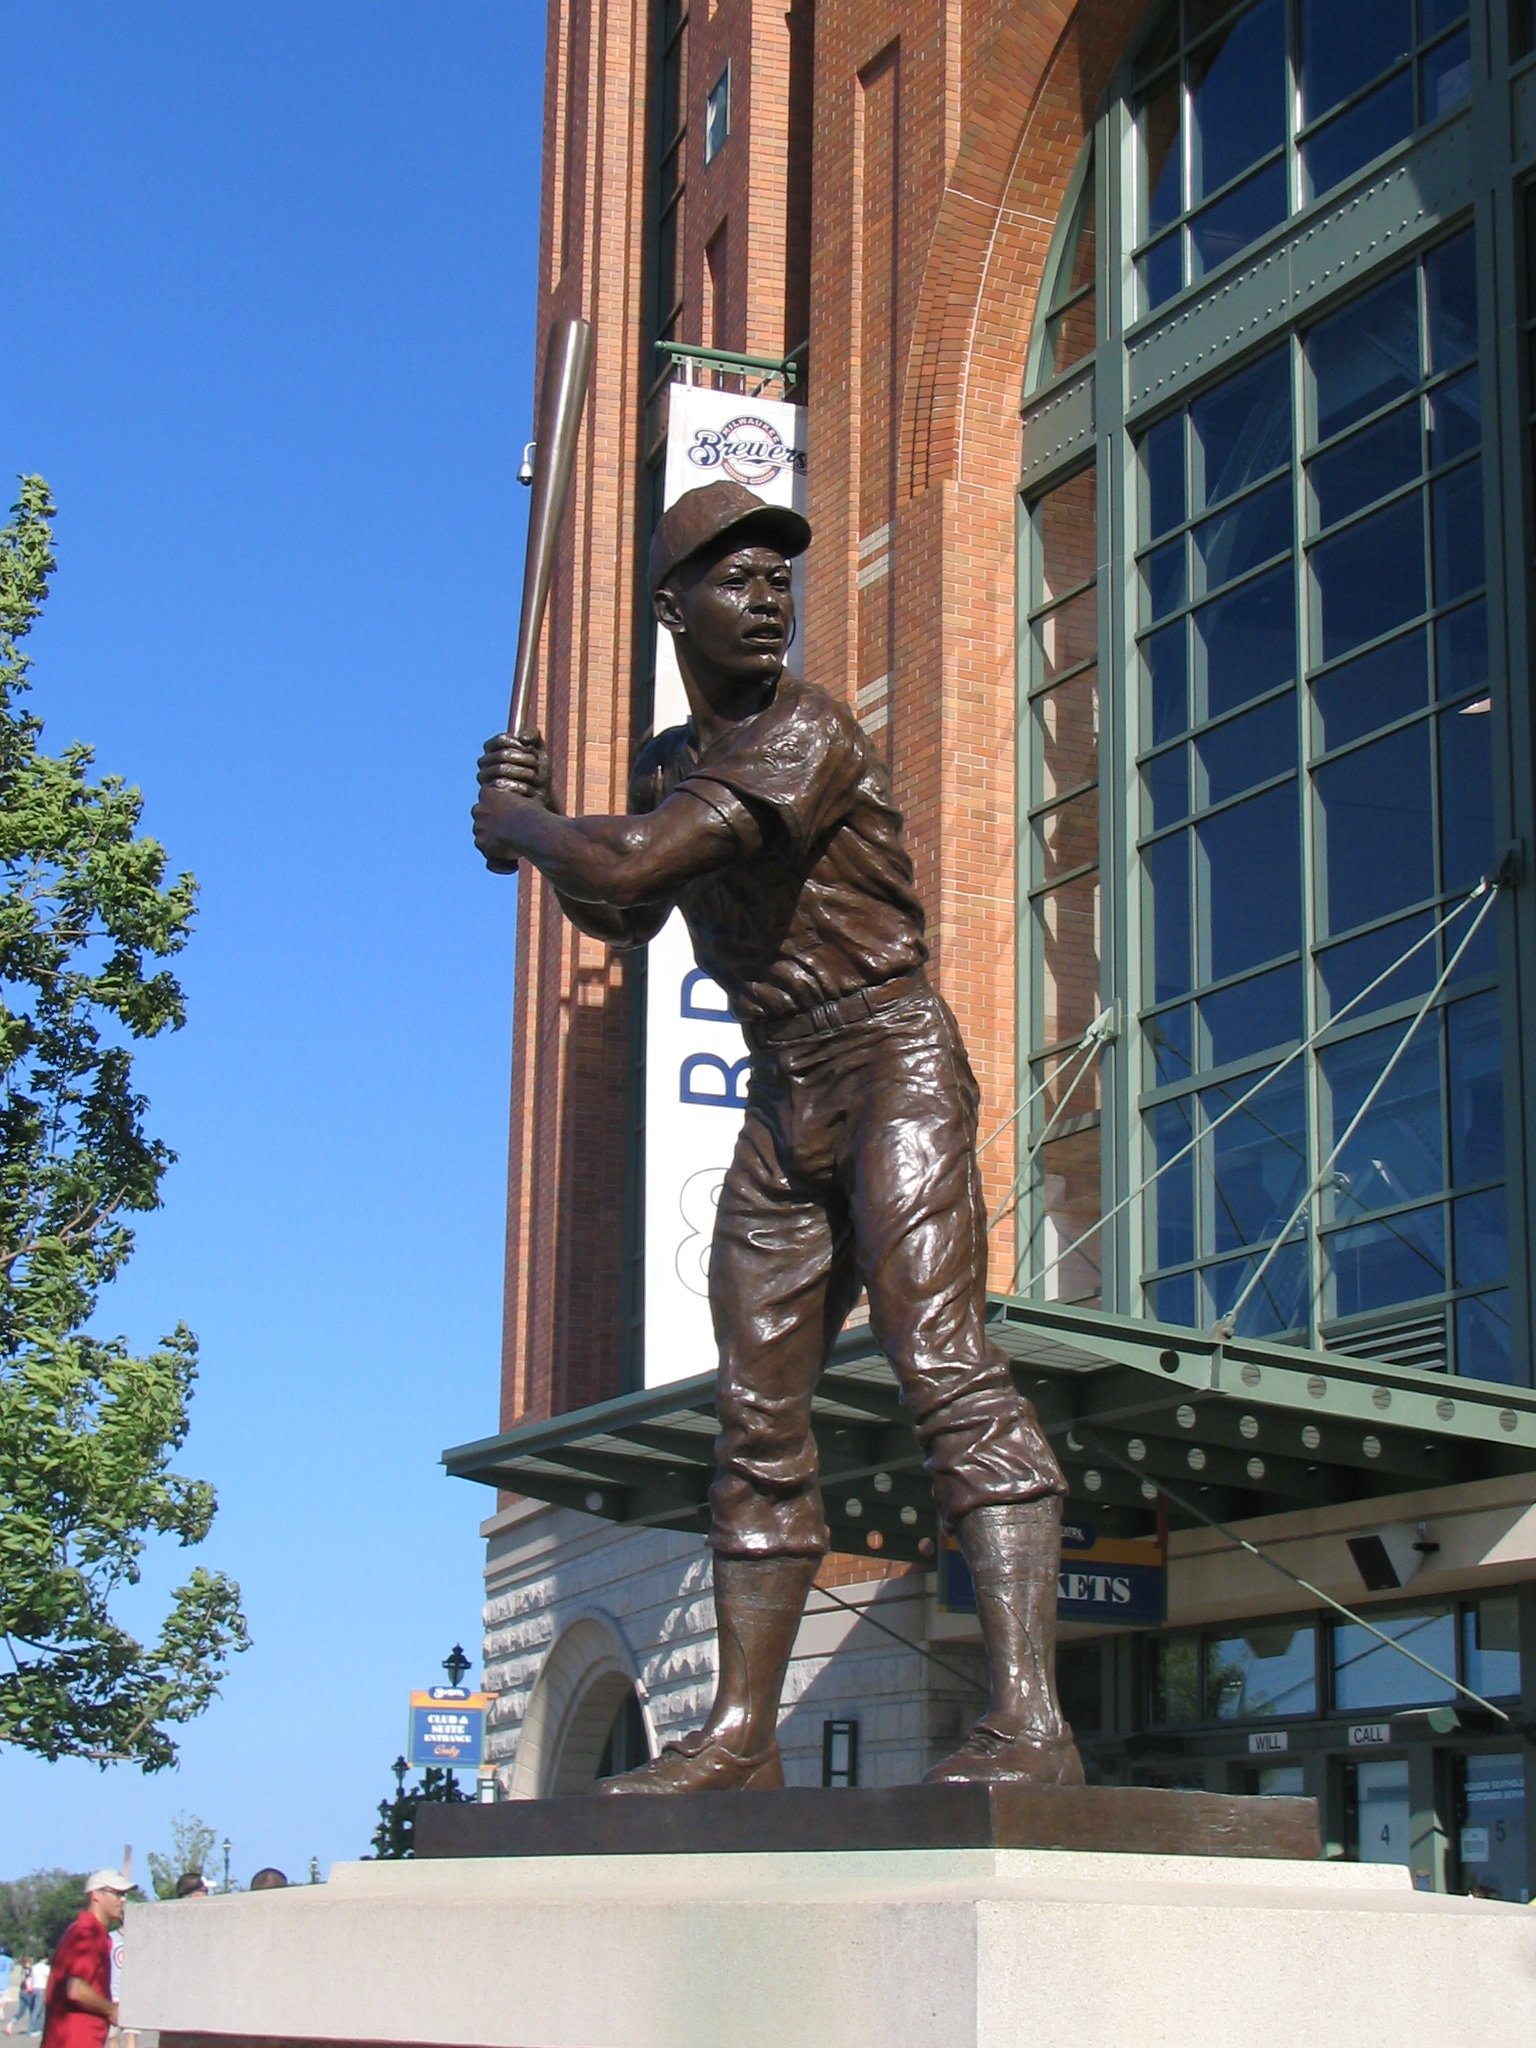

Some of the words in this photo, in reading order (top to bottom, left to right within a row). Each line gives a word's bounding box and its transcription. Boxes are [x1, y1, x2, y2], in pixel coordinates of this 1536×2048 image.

[722, 417, 780, 444] MILWAUKEE
[689, 430, 807, 475] Brewers
[427, 1714, 458, 1724] CLUB
[431, 1725, 465, 1734] SUITE
[424, 1734, 472, 1743] ENTRANCE
[1255, 1734, 1281, 1750] WILL
[1354, 1727, 1383, 1744] CALL
[1381, 1824, 1390, 1845] 4
[1495, 1820, 1505, 1842] 5
